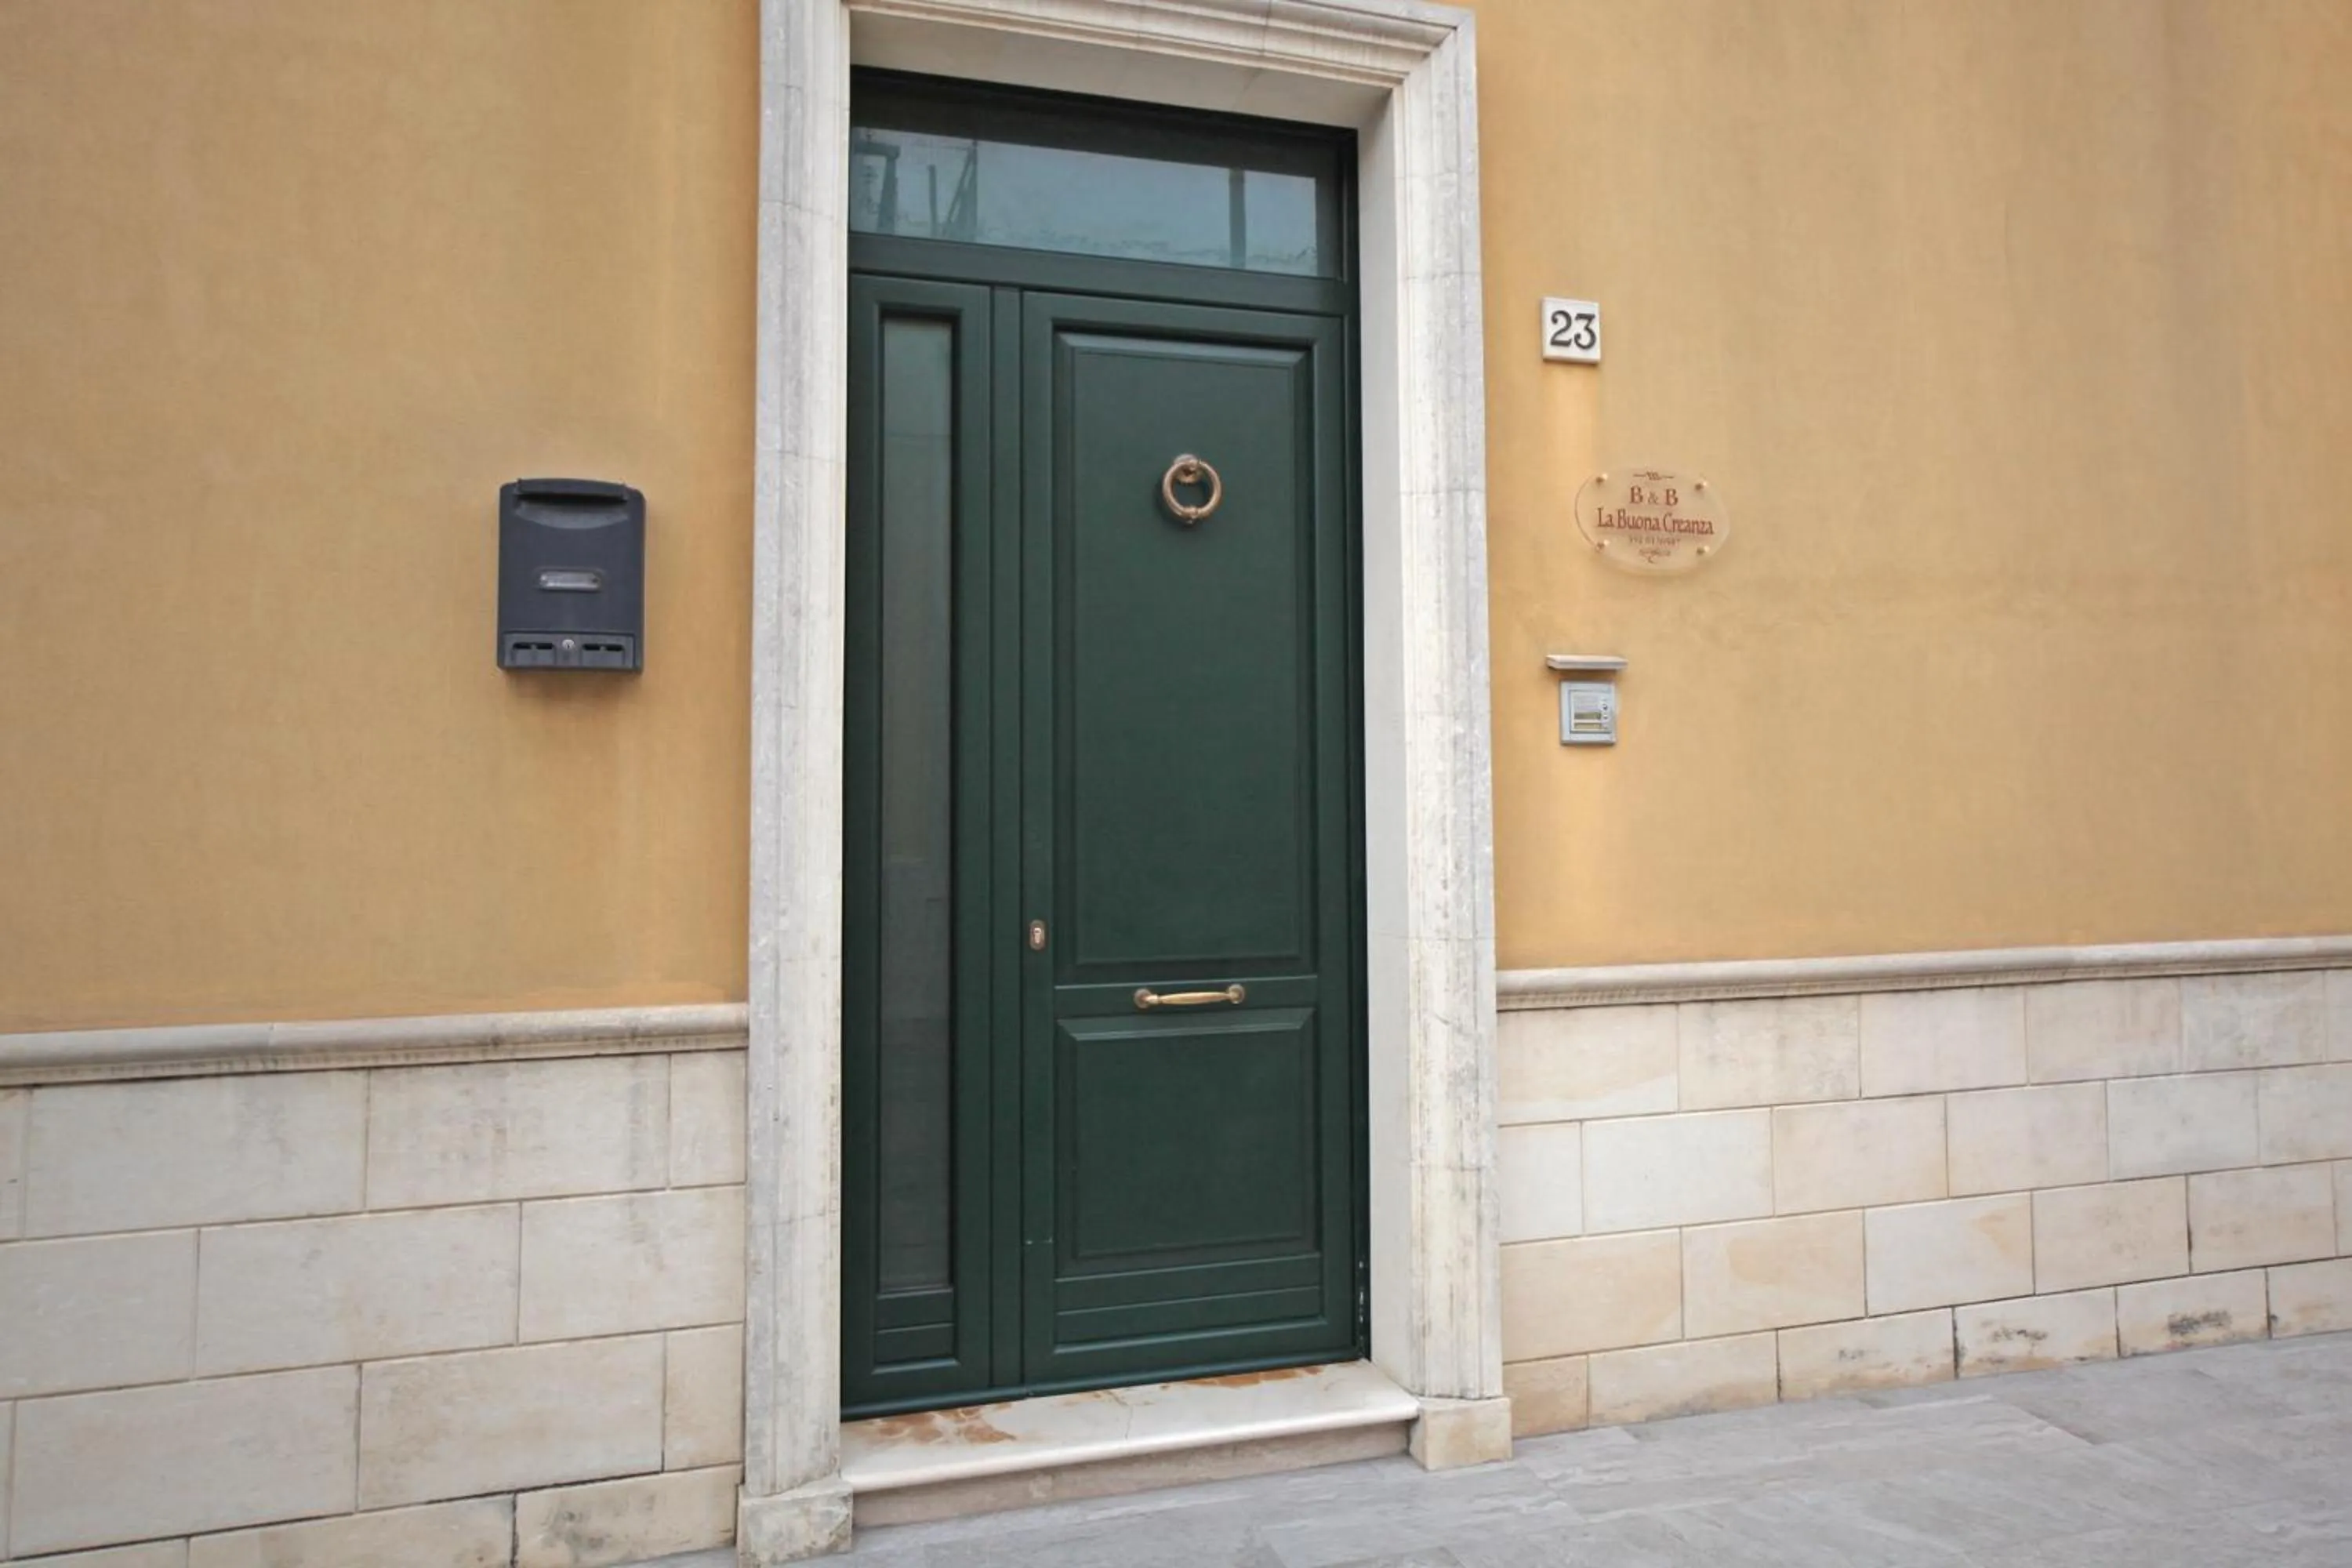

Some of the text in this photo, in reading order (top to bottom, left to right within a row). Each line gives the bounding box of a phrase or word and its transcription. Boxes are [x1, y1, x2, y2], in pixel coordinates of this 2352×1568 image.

[1550, 310, 1596, 350] 23
[1629, 485, 1679, 506] B & B
[1597, 507, 1715, 535] La Buona Creanza
